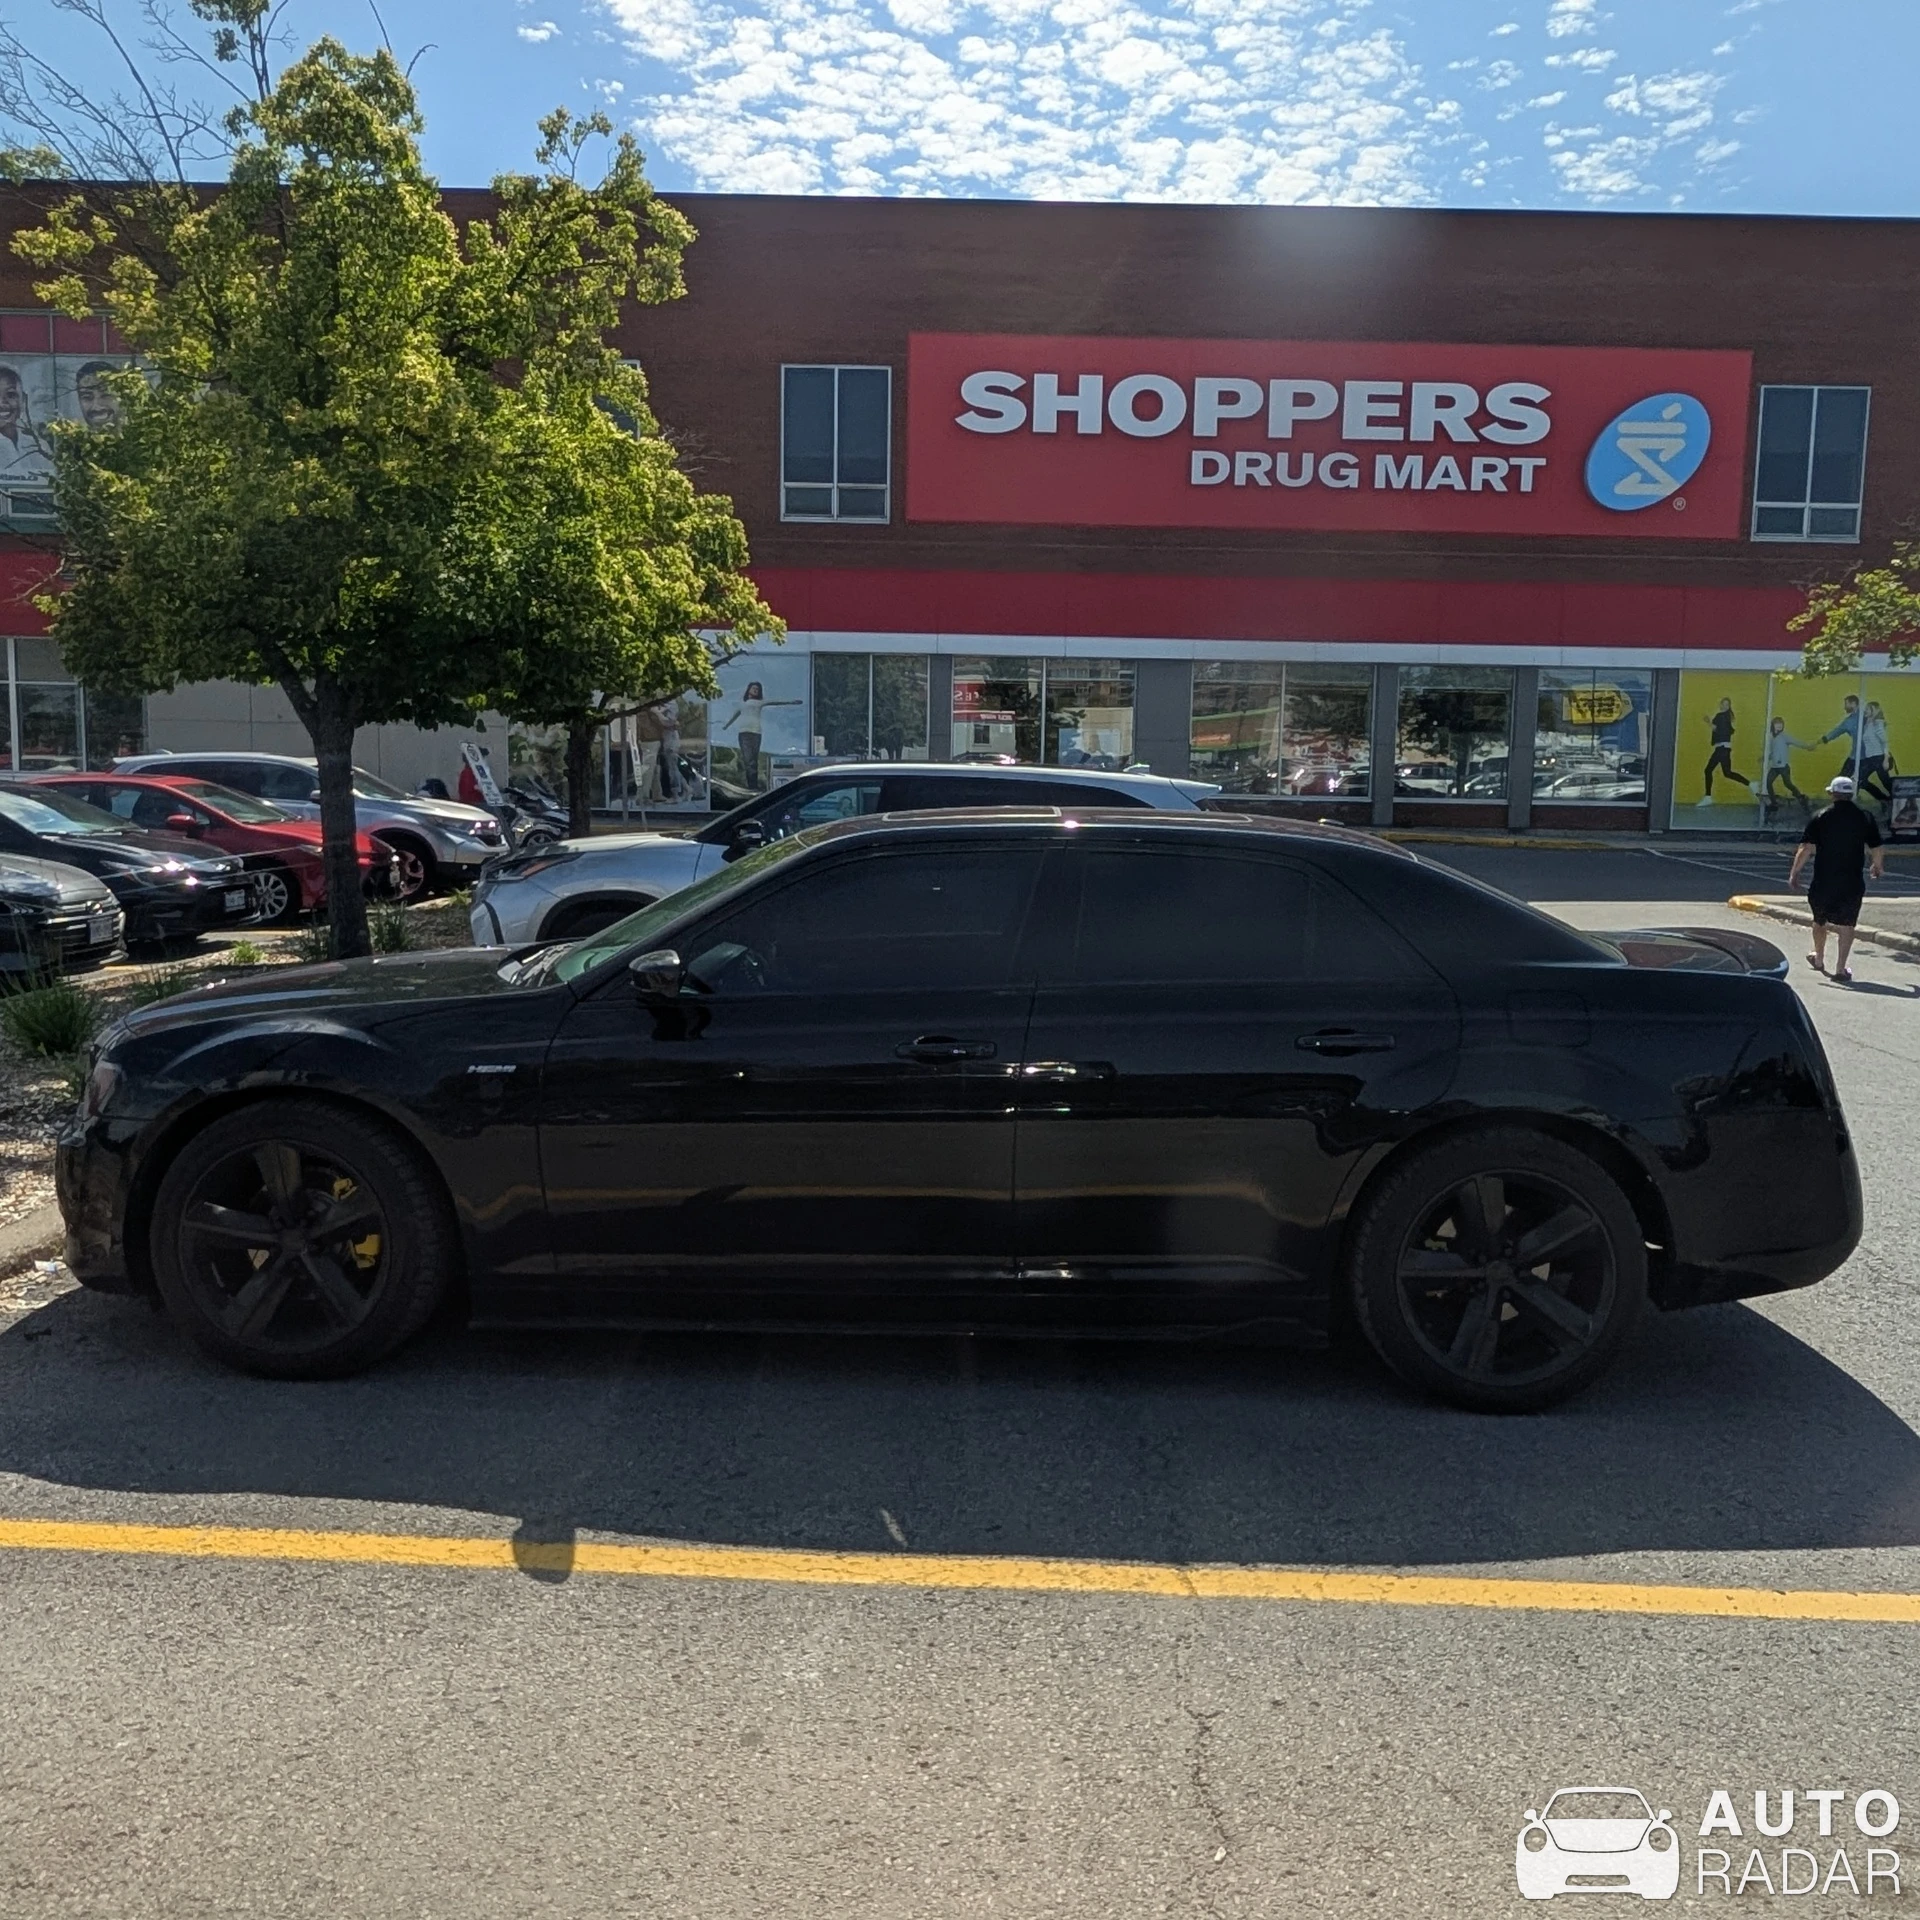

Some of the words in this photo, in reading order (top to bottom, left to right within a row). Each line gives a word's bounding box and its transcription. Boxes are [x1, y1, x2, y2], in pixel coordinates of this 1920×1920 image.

[954, 370, 1552, 445] SHOPPERS
[1190, 450, 1360, 488] DRUG
[1374, 454, 1547, 492] MART
